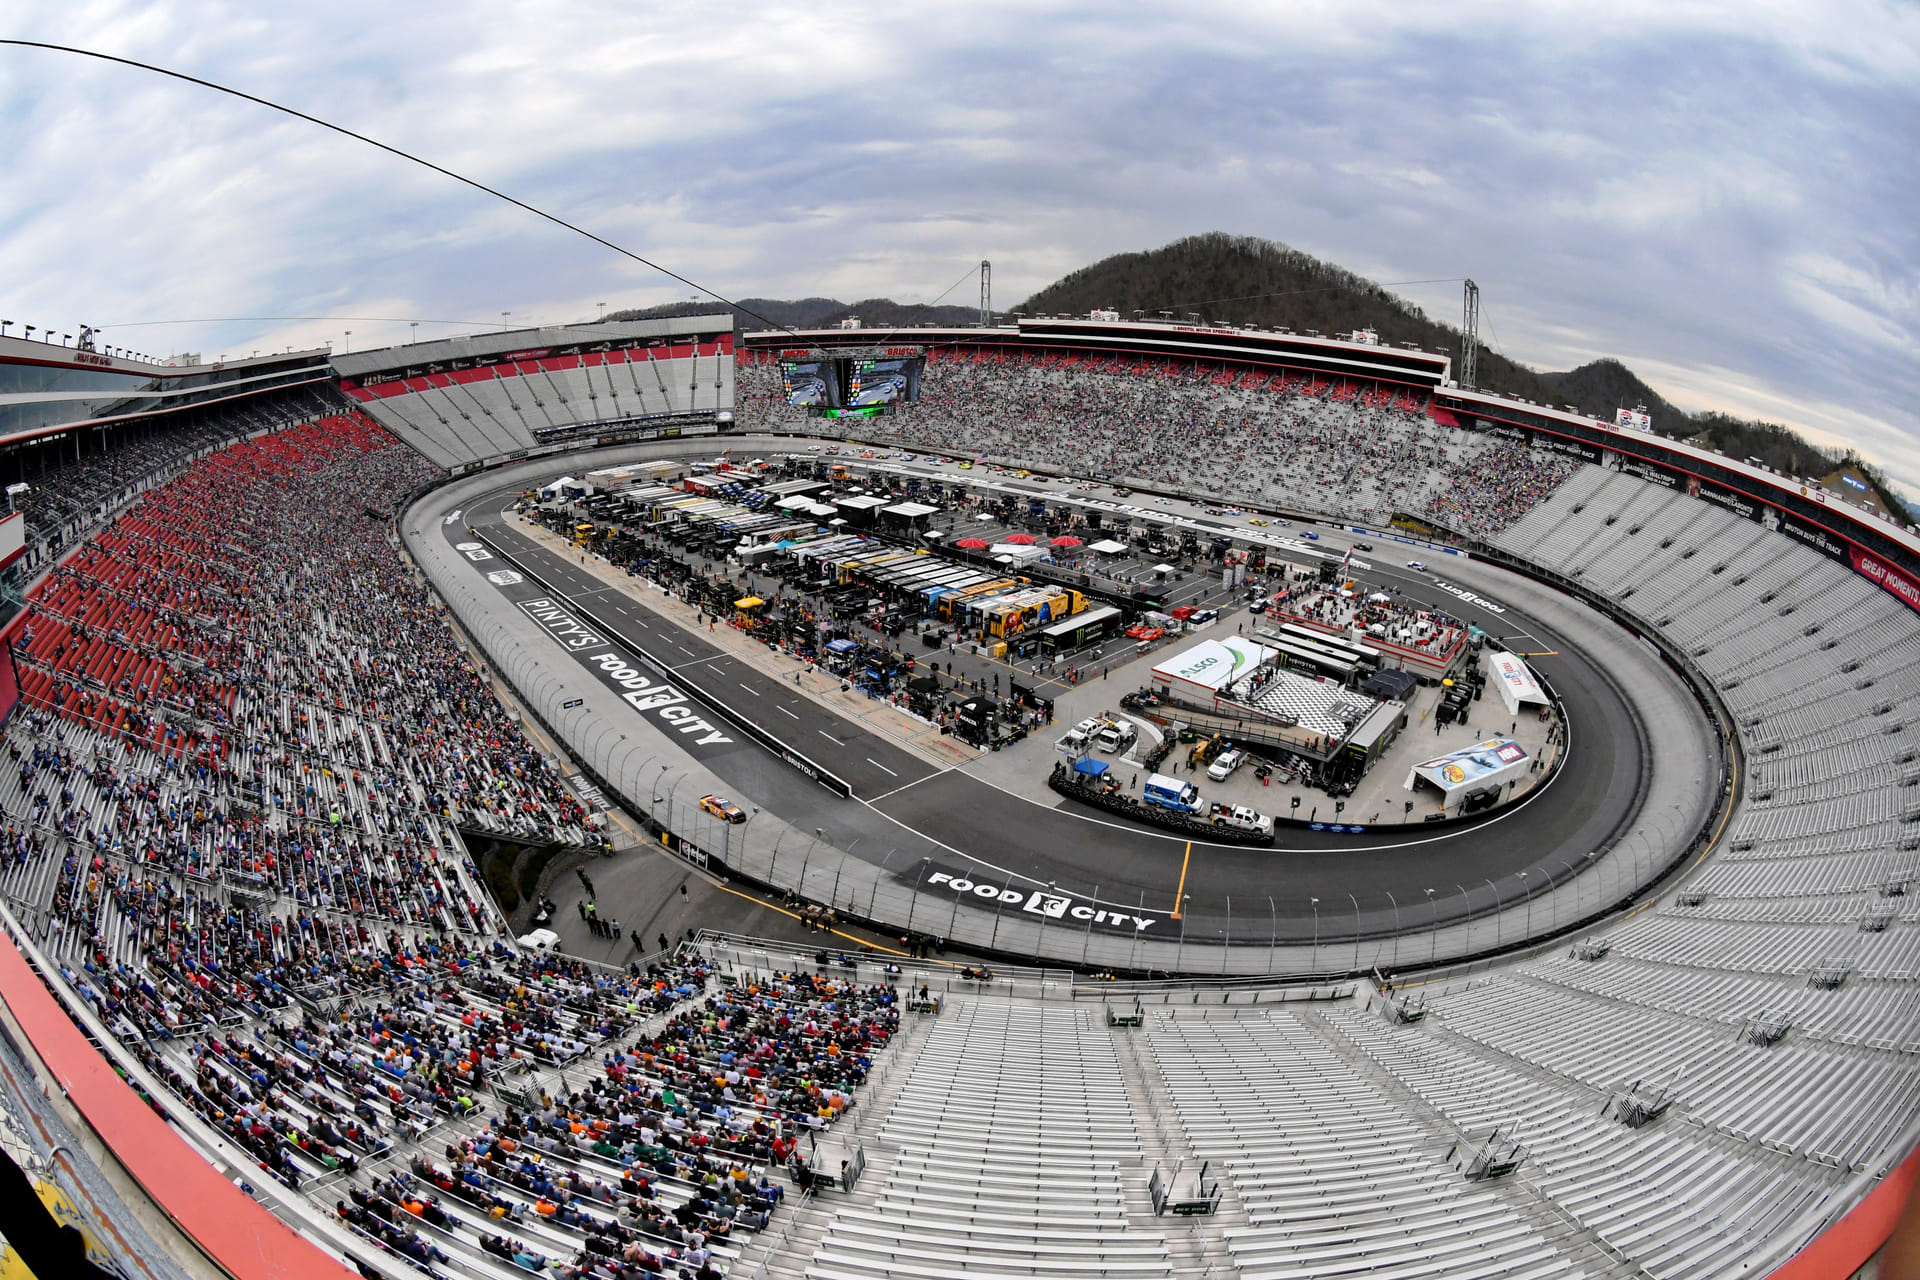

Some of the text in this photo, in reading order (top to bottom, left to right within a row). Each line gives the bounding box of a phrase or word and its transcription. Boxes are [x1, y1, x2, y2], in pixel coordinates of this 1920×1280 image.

[887, 347, 917, 355] BRISTOL
[1581, 450, 1595, 459] RACE
[1784, 523, 1842, 556] BRUTON BUYS THE TRACK
[1861, 557, 1919, 603] GREAT MOMENTS
[1437, 582, 1505, 613] FOOD CITY
[525, 600, 598, 647] PINTY'S
[589, 652, 651, 689] FOOD
[659, 706, 734, 745] CITY
[787, 755, 813, 777] BRISTOL
[928, 871, 1024, 904] FOOD
[1070, 905, 1156, 931] CITY
